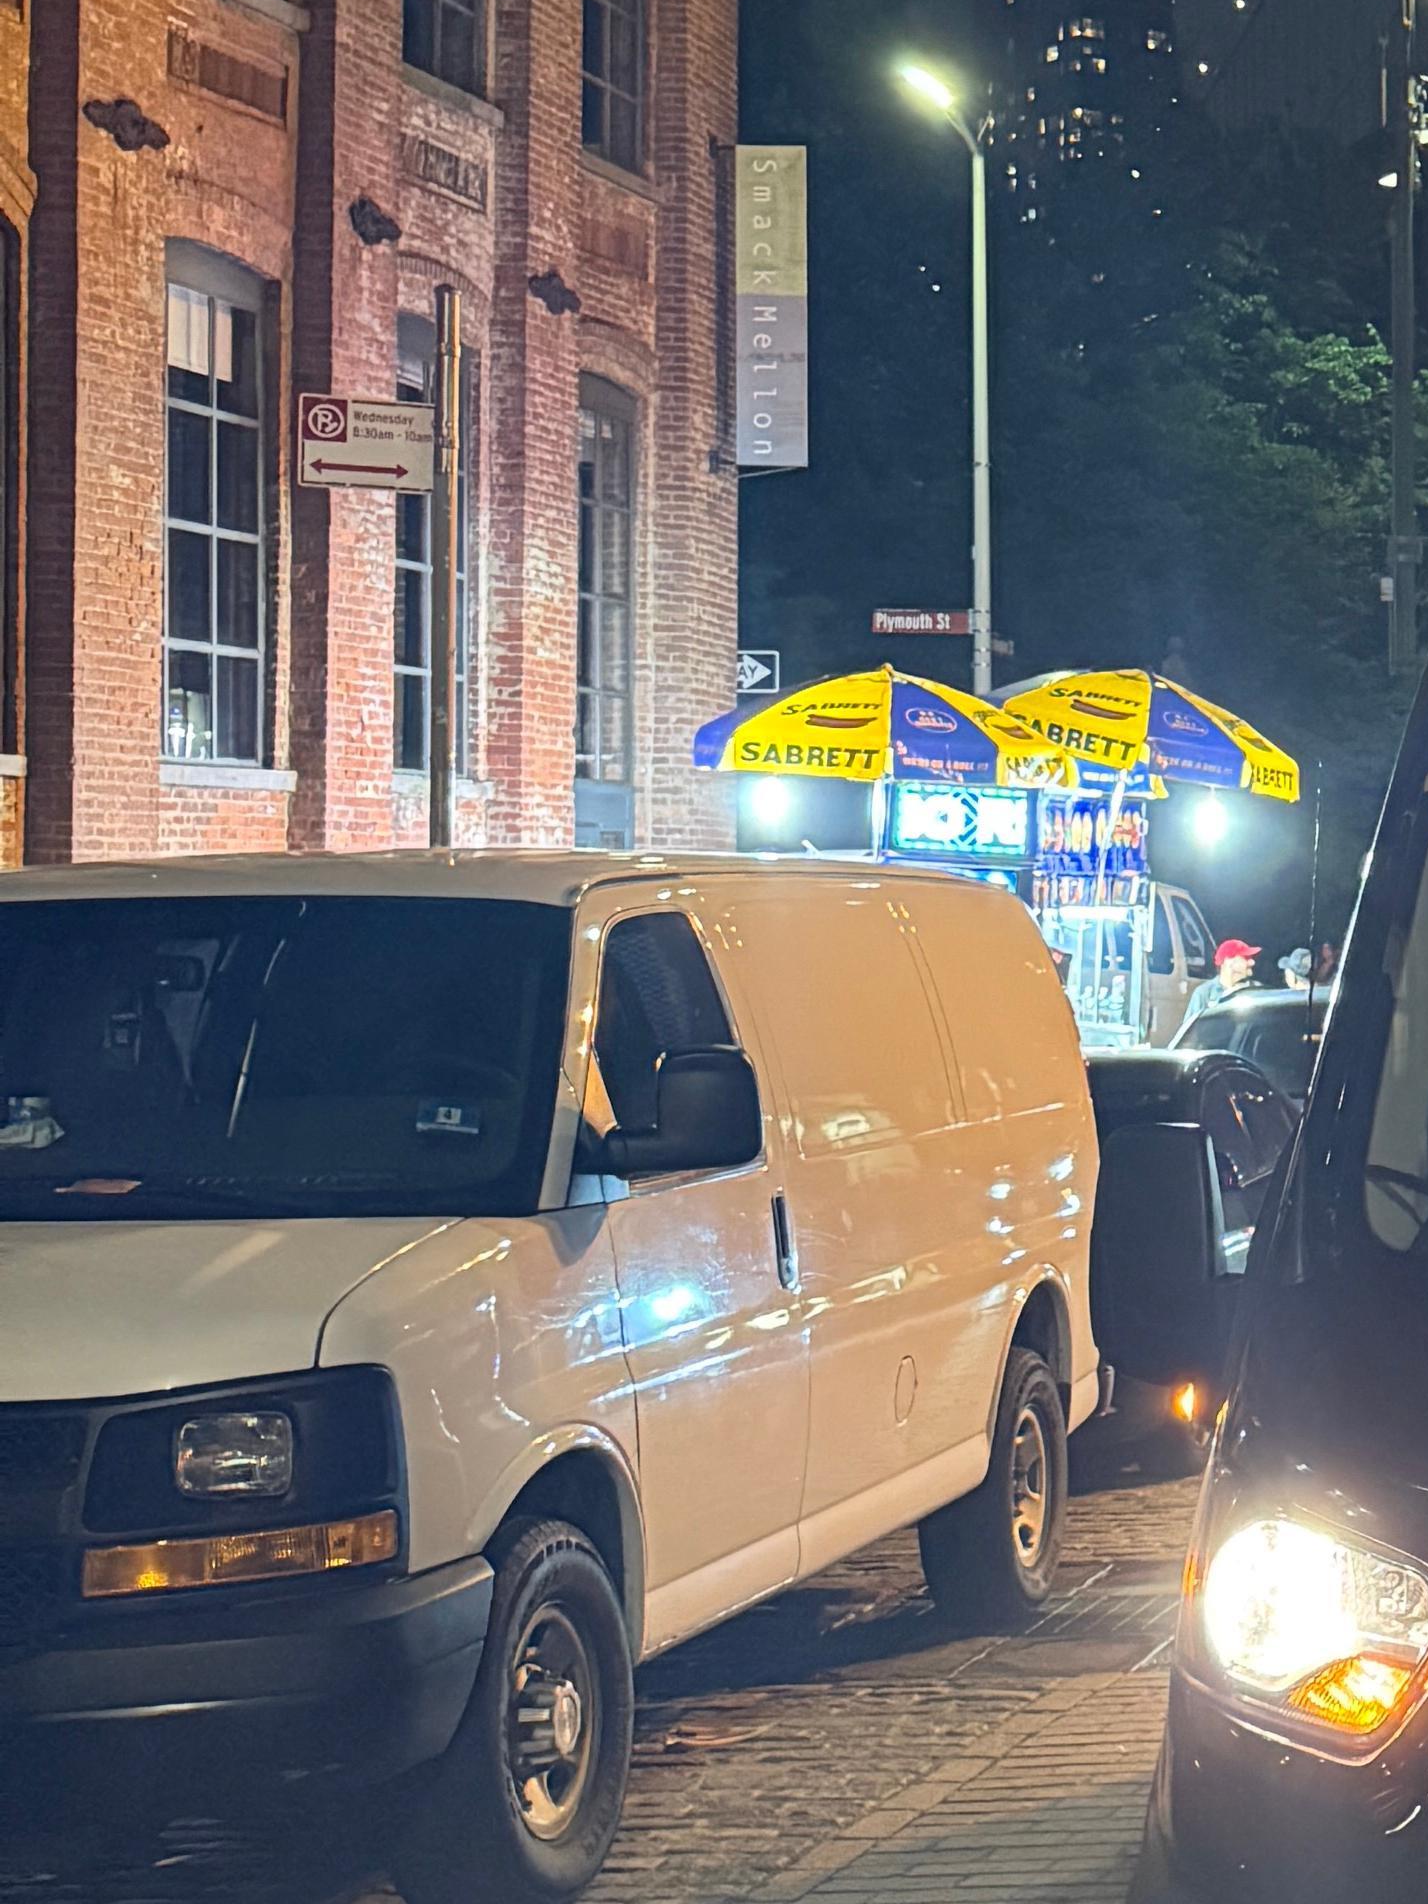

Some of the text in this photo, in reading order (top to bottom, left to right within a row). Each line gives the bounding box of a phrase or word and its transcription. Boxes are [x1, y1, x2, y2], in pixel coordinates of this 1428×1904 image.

[752, 159, 777, 454] Smack Mellon
[353, 410, 415, 427] Wednesday
[877, 612, 951, 632] Plymouth St
[740, 742, 880, 769] SABRETT
